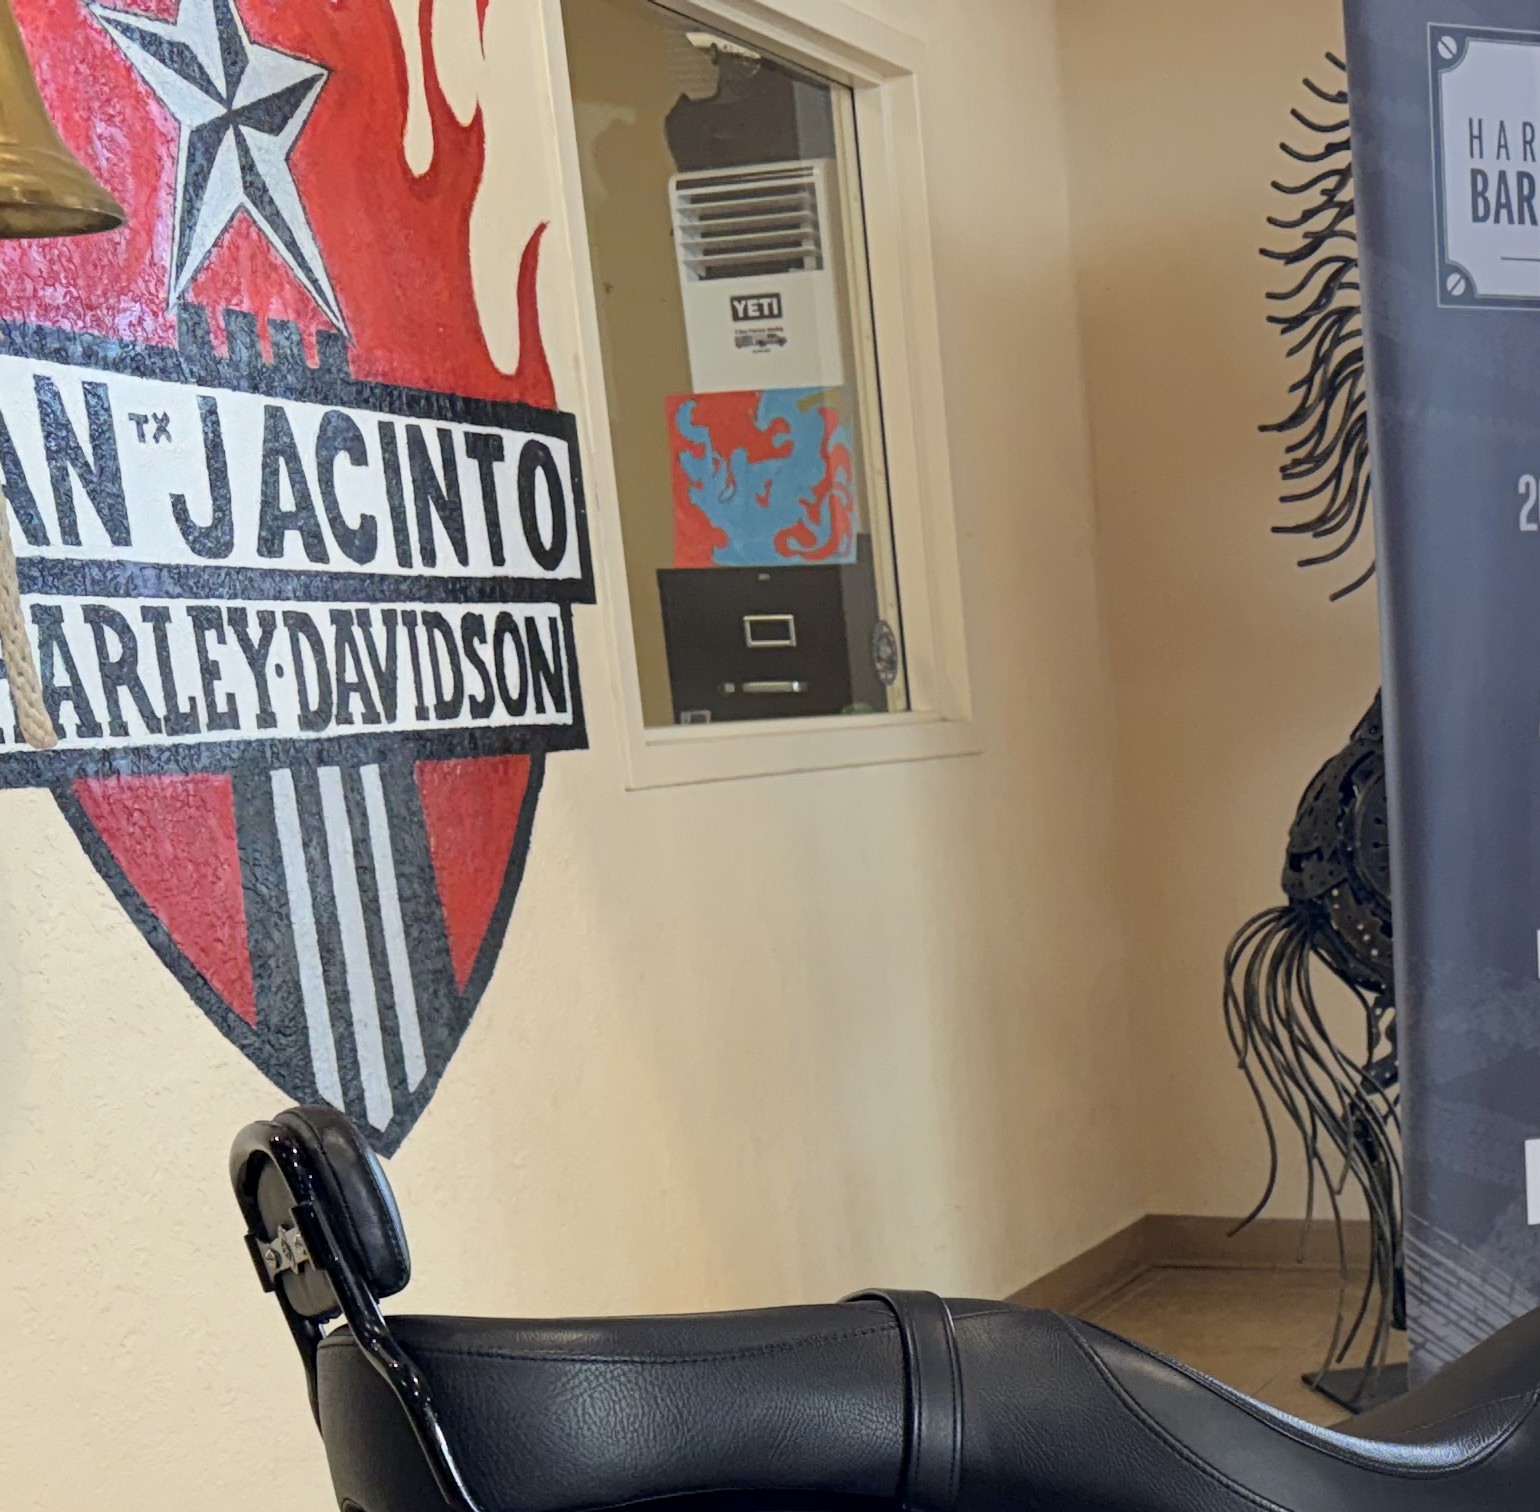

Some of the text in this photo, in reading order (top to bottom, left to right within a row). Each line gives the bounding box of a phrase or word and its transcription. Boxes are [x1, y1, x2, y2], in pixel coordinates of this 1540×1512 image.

[1470, 168, 1538, 227] BAR
[732, 297, 779, 319] YETI
[128, 411, 173, 445] TX
[169, 394, 568, 571] JACINTO
